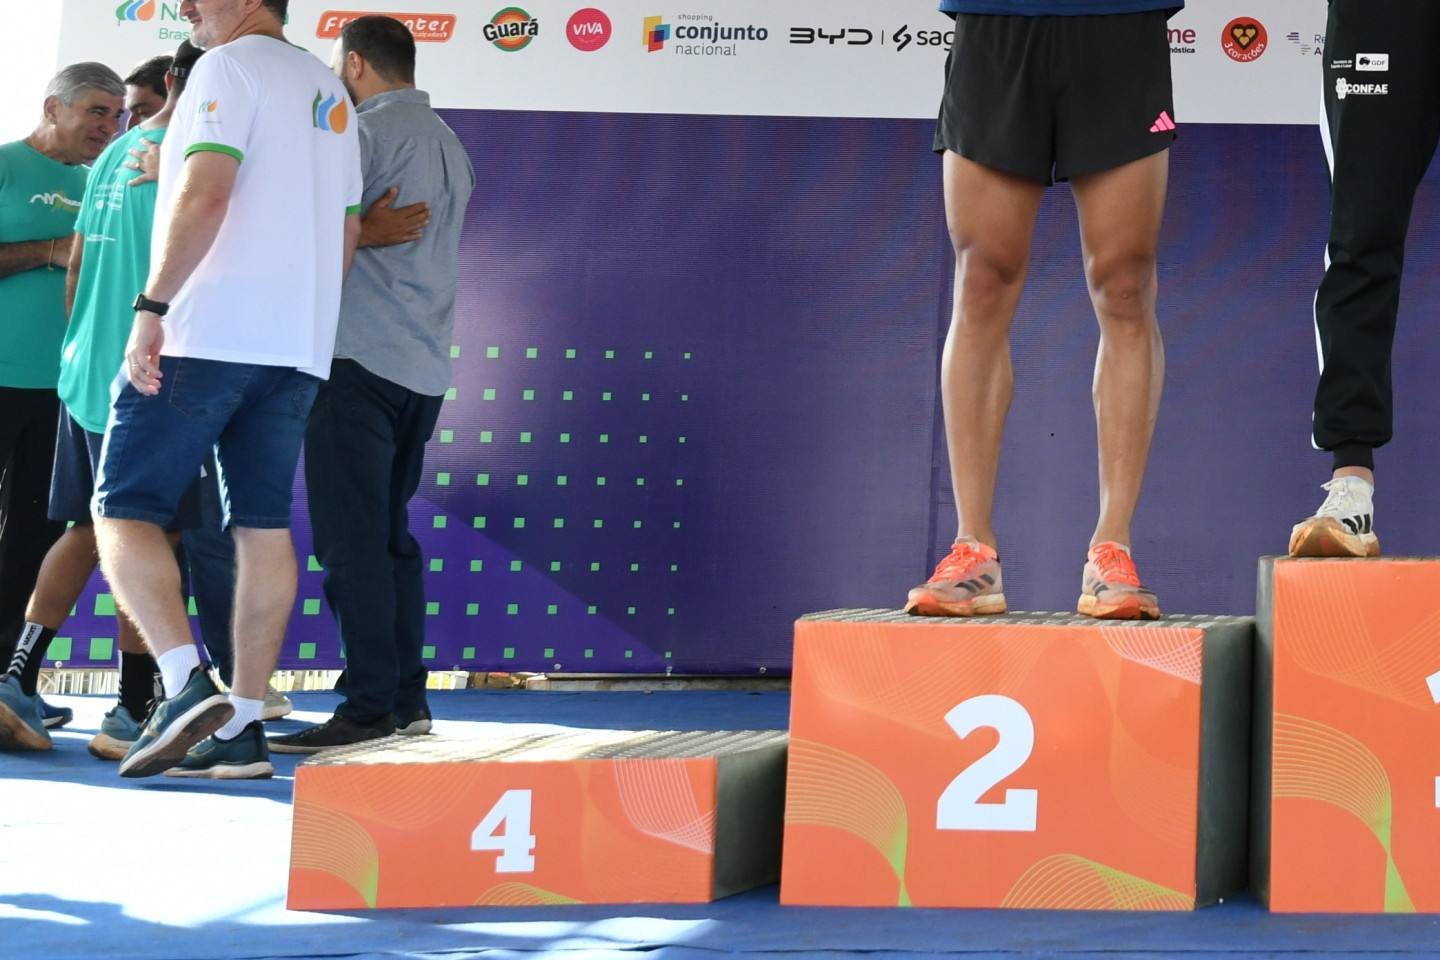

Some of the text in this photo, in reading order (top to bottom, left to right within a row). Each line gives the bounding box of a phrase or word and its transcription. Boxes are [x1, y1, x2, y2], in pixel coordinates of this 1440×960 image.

[482, 18, 539, 42] Guará
[572, 22, 603, 36] VIVA
[675, 22, 768, 43] conjunto
[789, 27, 873, 45] BYD
[675, 43, 737, 56] nacional
[1346, 83, 1389, 93] CONFAE
[937, 695, 1038, 832] 2
[471, 790, 536, 873] 4
